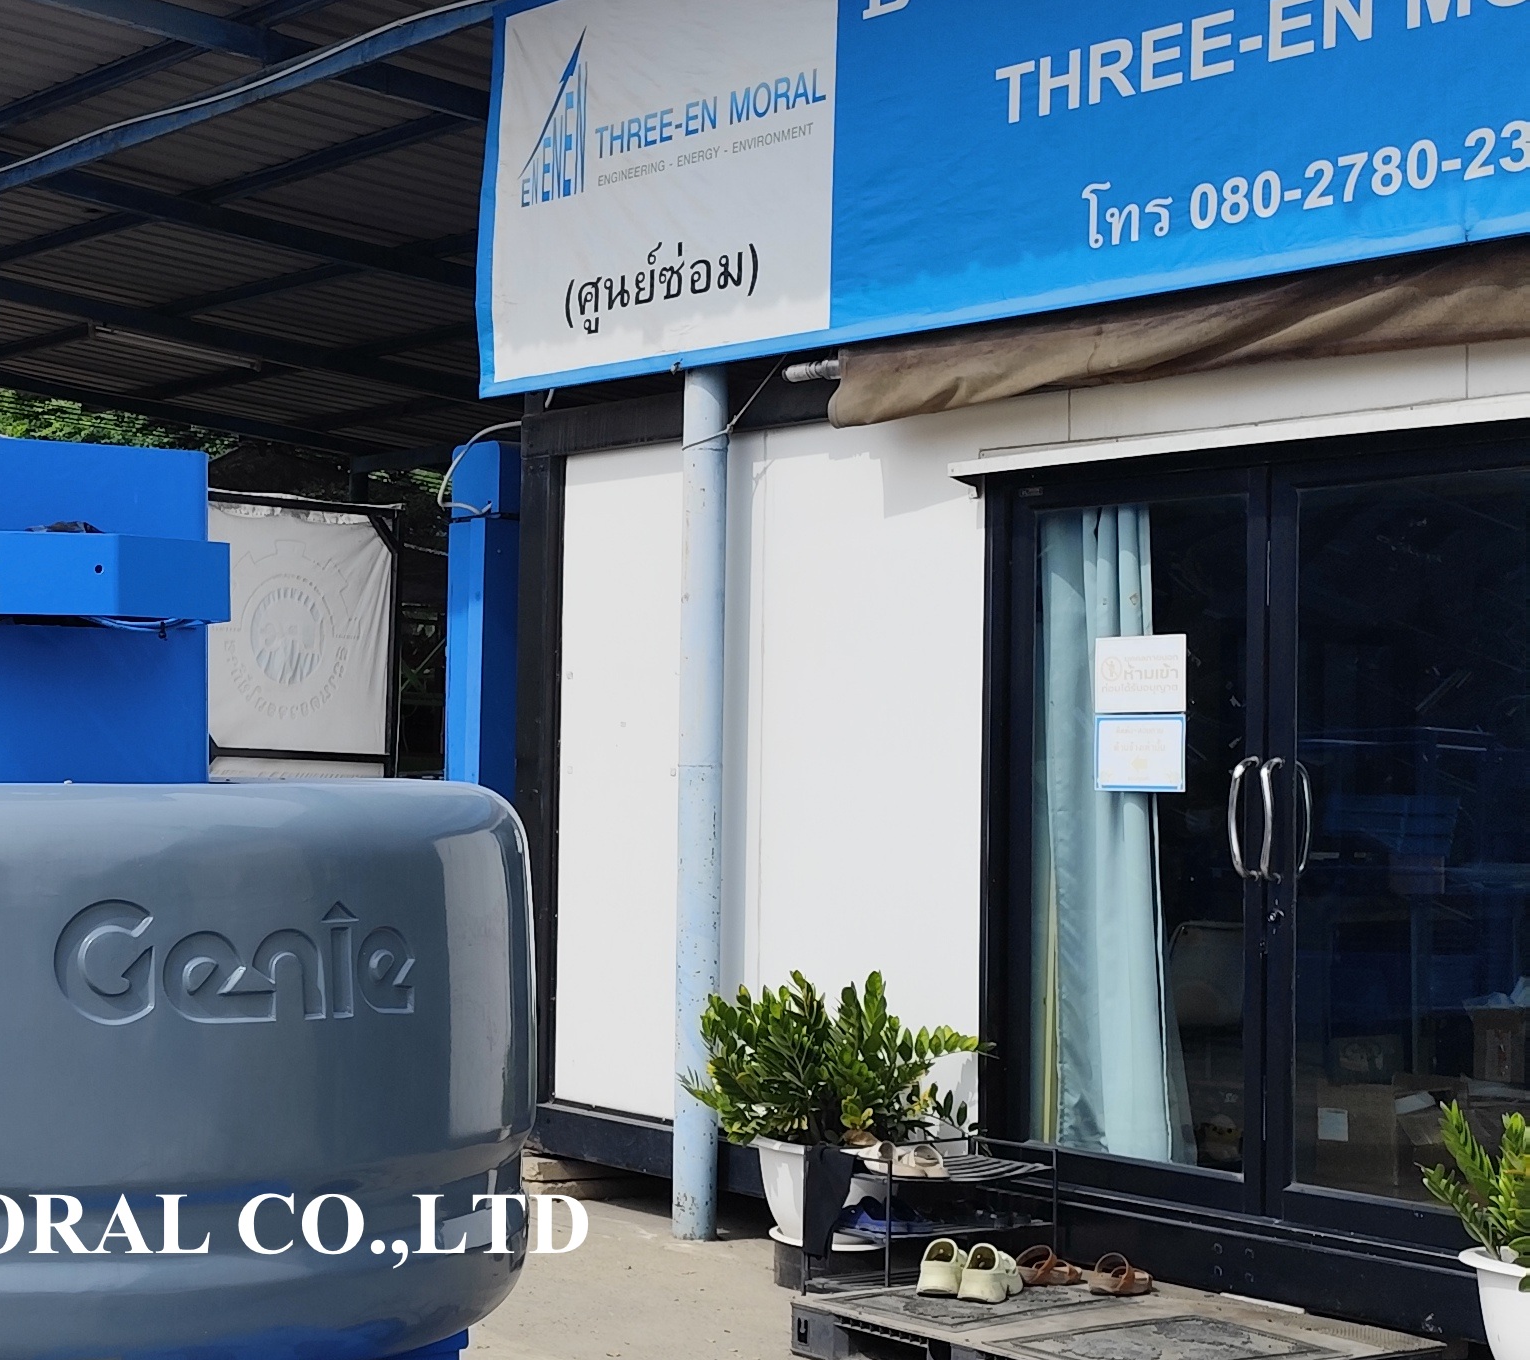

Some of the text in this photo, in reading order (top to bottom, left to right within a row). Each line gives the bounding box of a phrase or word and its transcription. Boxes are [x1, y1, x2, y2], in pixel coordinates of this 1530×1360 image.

[594, 67, 827, 159] THREE-EN MORAL
[597, 159, 666, 187] ENGINEERING
[676, 145, 721, 168] ENERGY
[731, 121, 815, 154] ENVIRONMENT
[1081, 120, 1530, 250] โทร 080-2780-23
[564, 241, 760, 335] (ศูนย์ซ่อม)
[1123, 662, 1179, 680] ห้ามเข้า
[53, 898, 417, 1028] Genie
